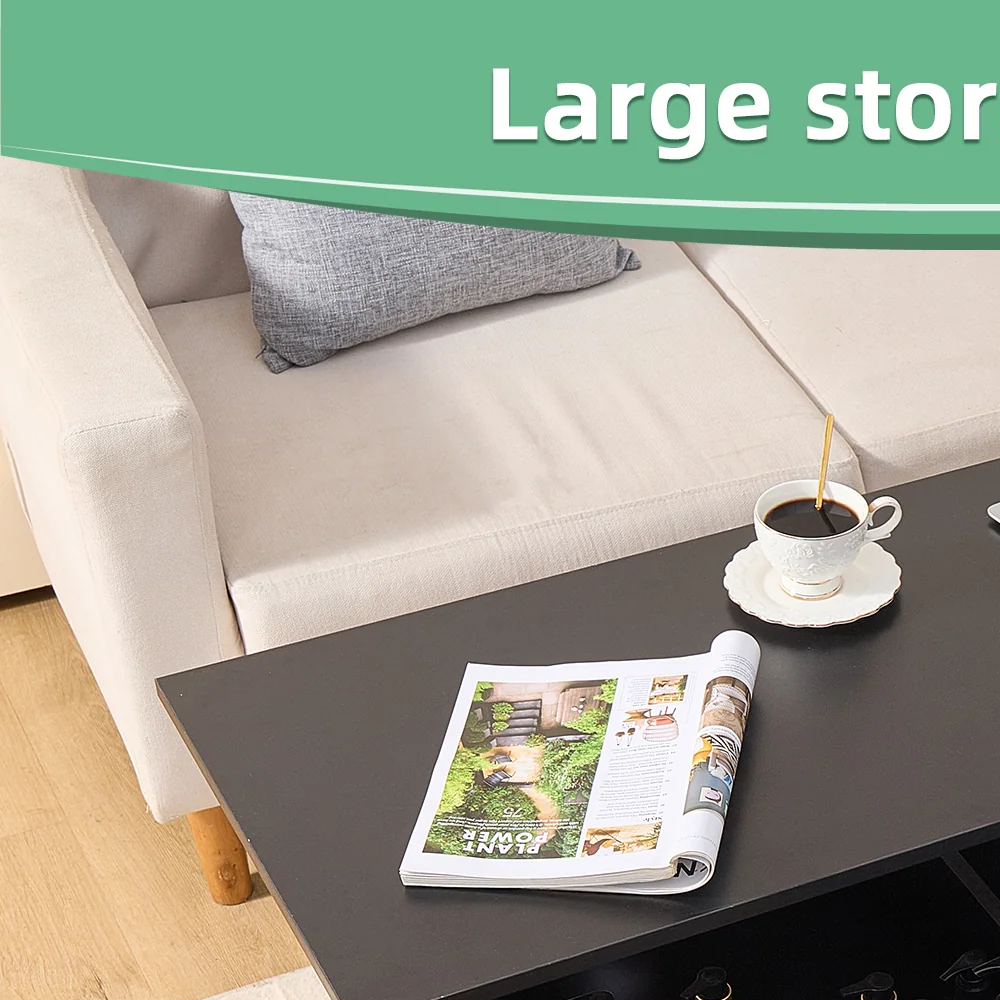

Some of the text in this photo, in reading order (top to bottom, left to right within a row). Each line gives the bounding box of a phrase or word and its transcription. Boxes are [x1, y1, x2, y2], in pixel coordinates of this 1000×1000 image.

[502, 806, 523, 818] 75
[463, 829, 548, 843] POWER
[463, 842, 541, 855] PLANT
